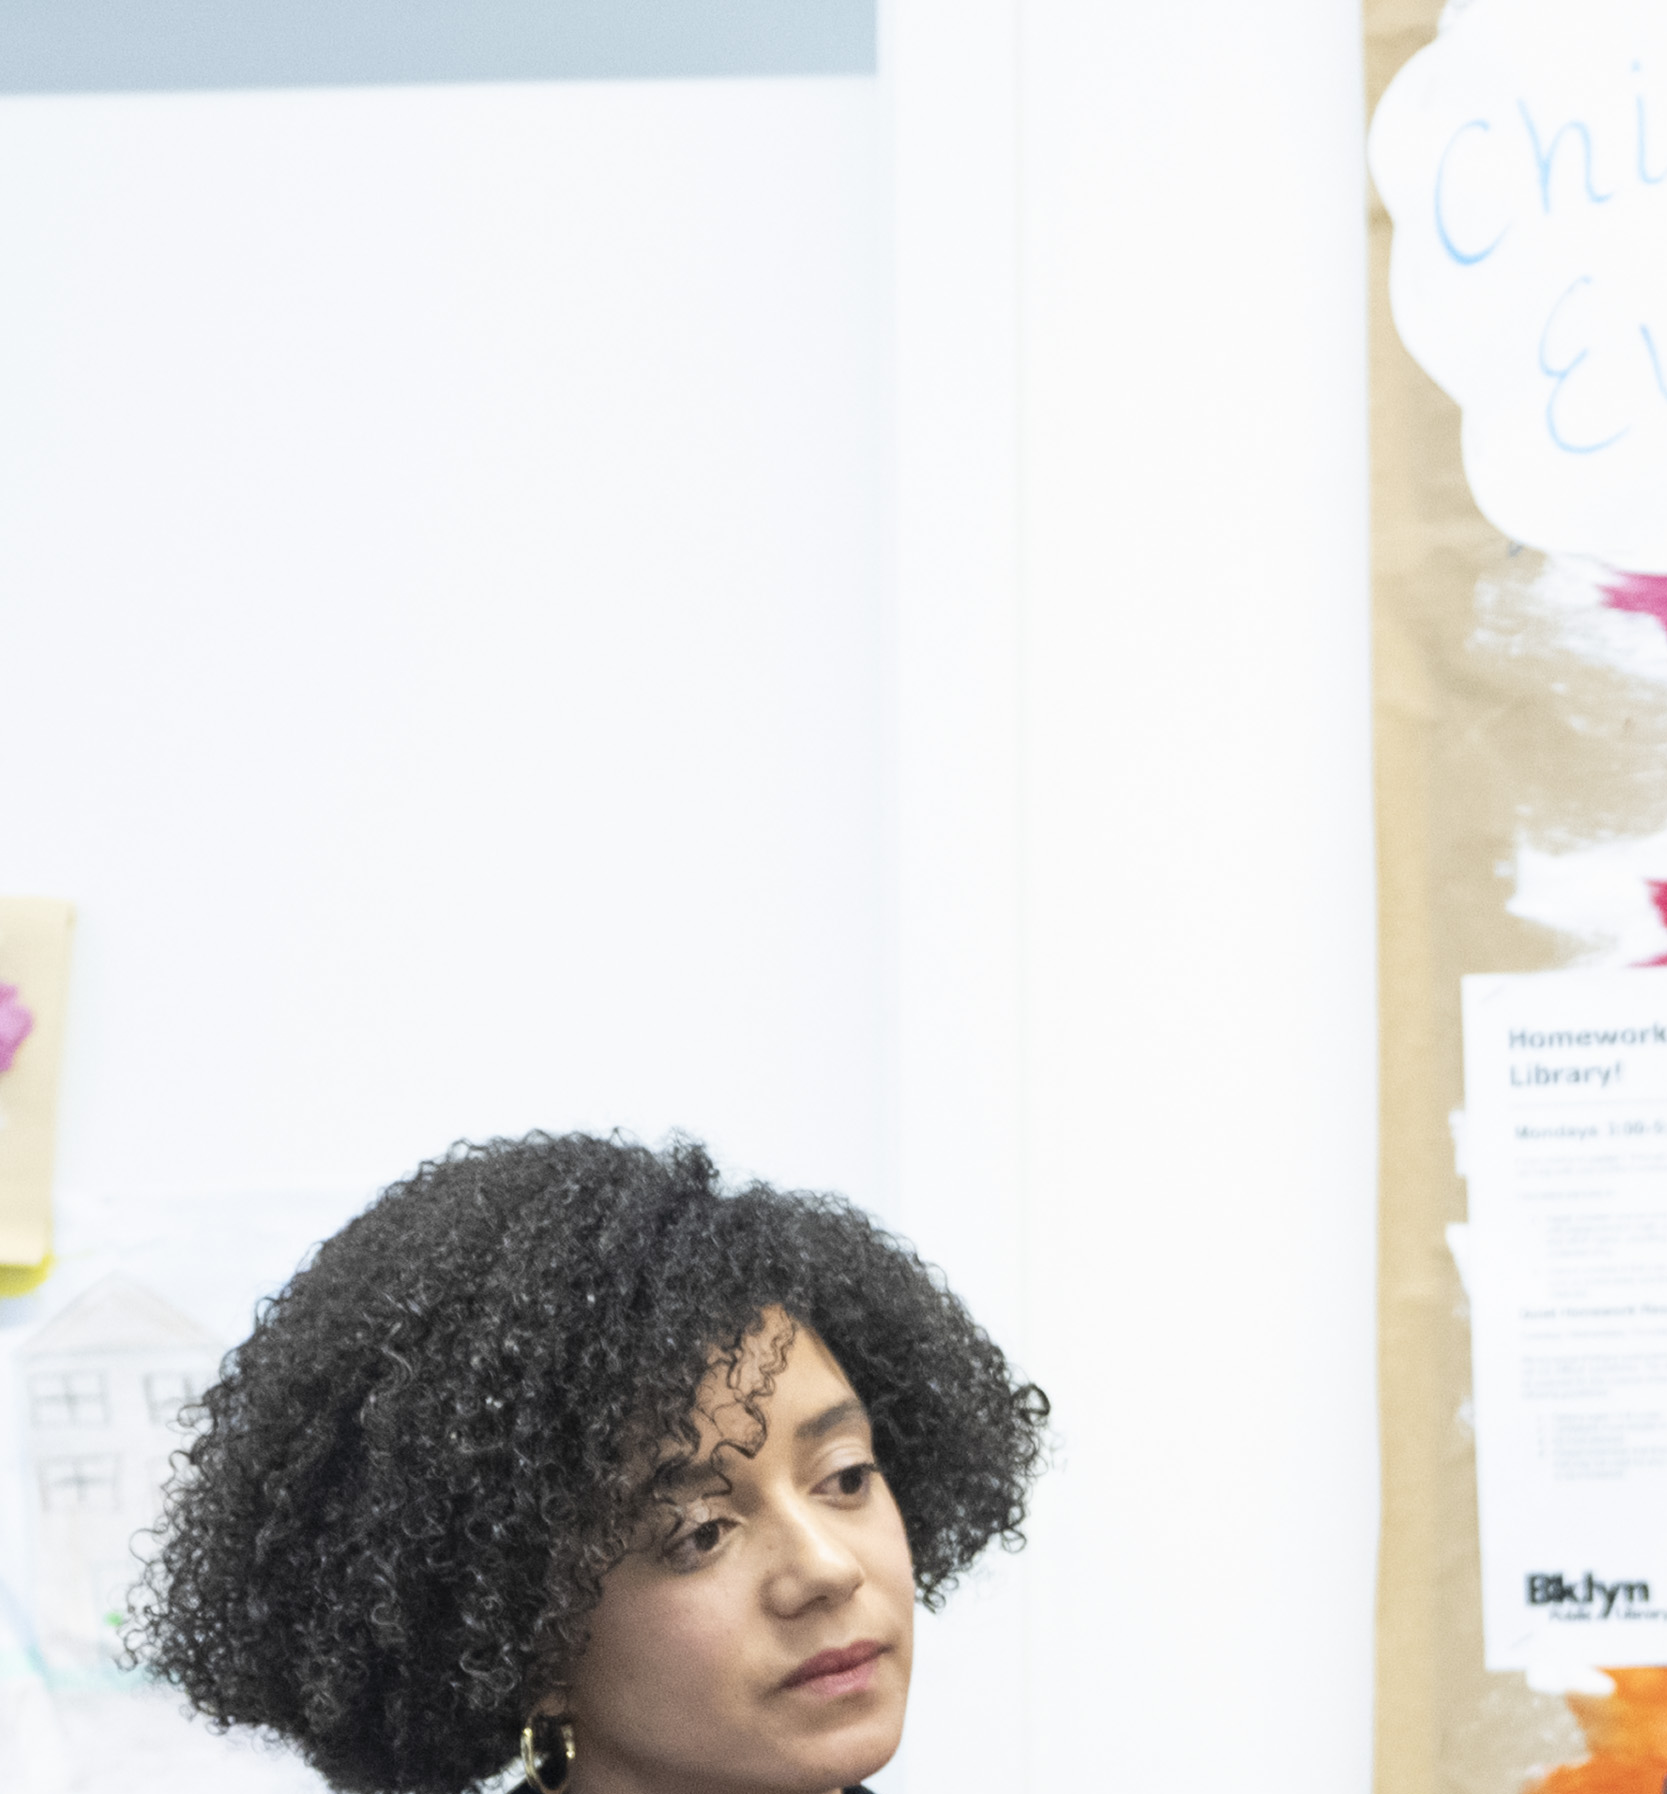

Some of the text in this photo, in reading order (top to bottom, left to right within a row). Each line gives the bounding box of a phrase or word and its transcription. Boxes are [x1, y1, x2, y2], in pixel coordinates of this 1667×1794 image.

[1509, 1060, 1622, 1089] Library!
[1514, 1123, 1600, 1143] Mondays
[1525, 1571, 1650, 1620] Bklyn
